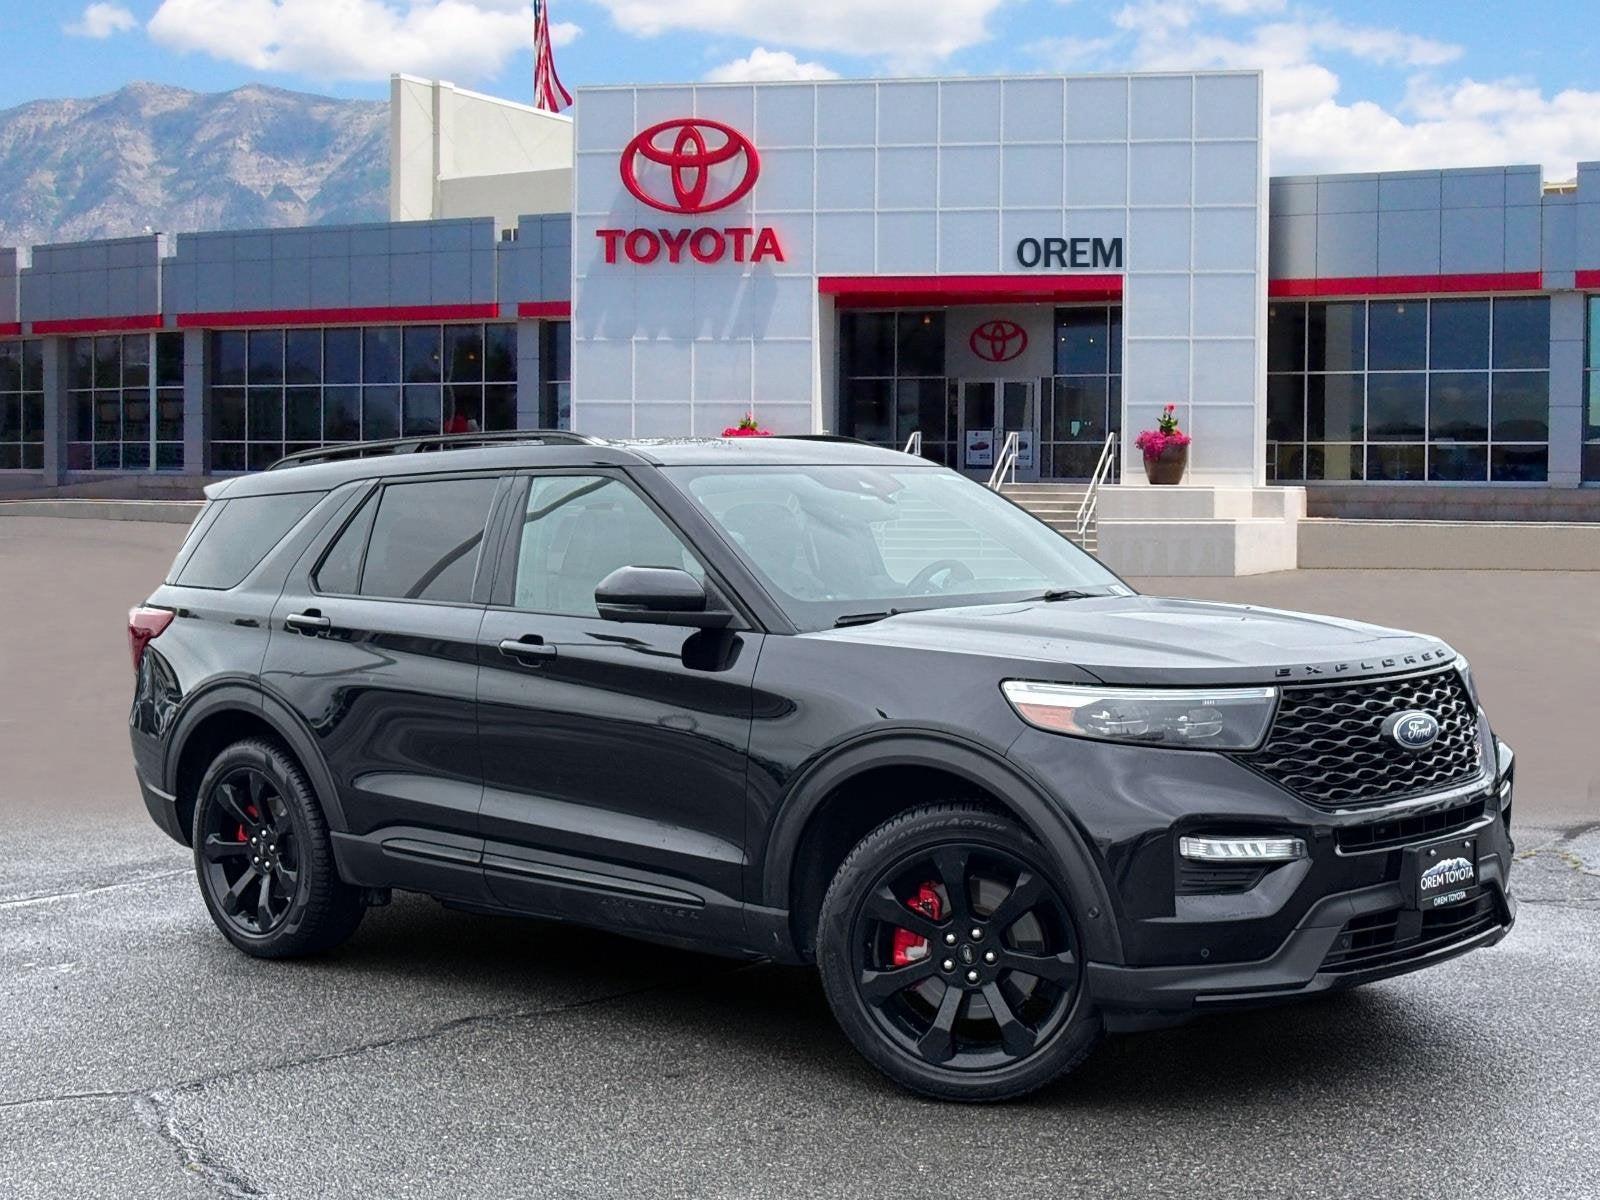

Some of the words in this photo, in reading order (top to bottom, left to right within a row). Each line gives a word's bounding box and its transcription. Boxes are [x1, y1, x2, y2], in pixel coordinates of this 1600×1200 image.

[596, 227, 785, 264] TOYOTA
[1016, 237, 1123, 269] OREM
[1275, 649, 1446, 678] EXPLORER
[1408, 720, 1431, 739] Ford
[1420, 874, 1444, 890] OREM
[1445, 866, 1474, 884] TOYOTA
[1433, 896, 1447, 907] OREM
[1448, 891, 1466, 902] TOYOTA
